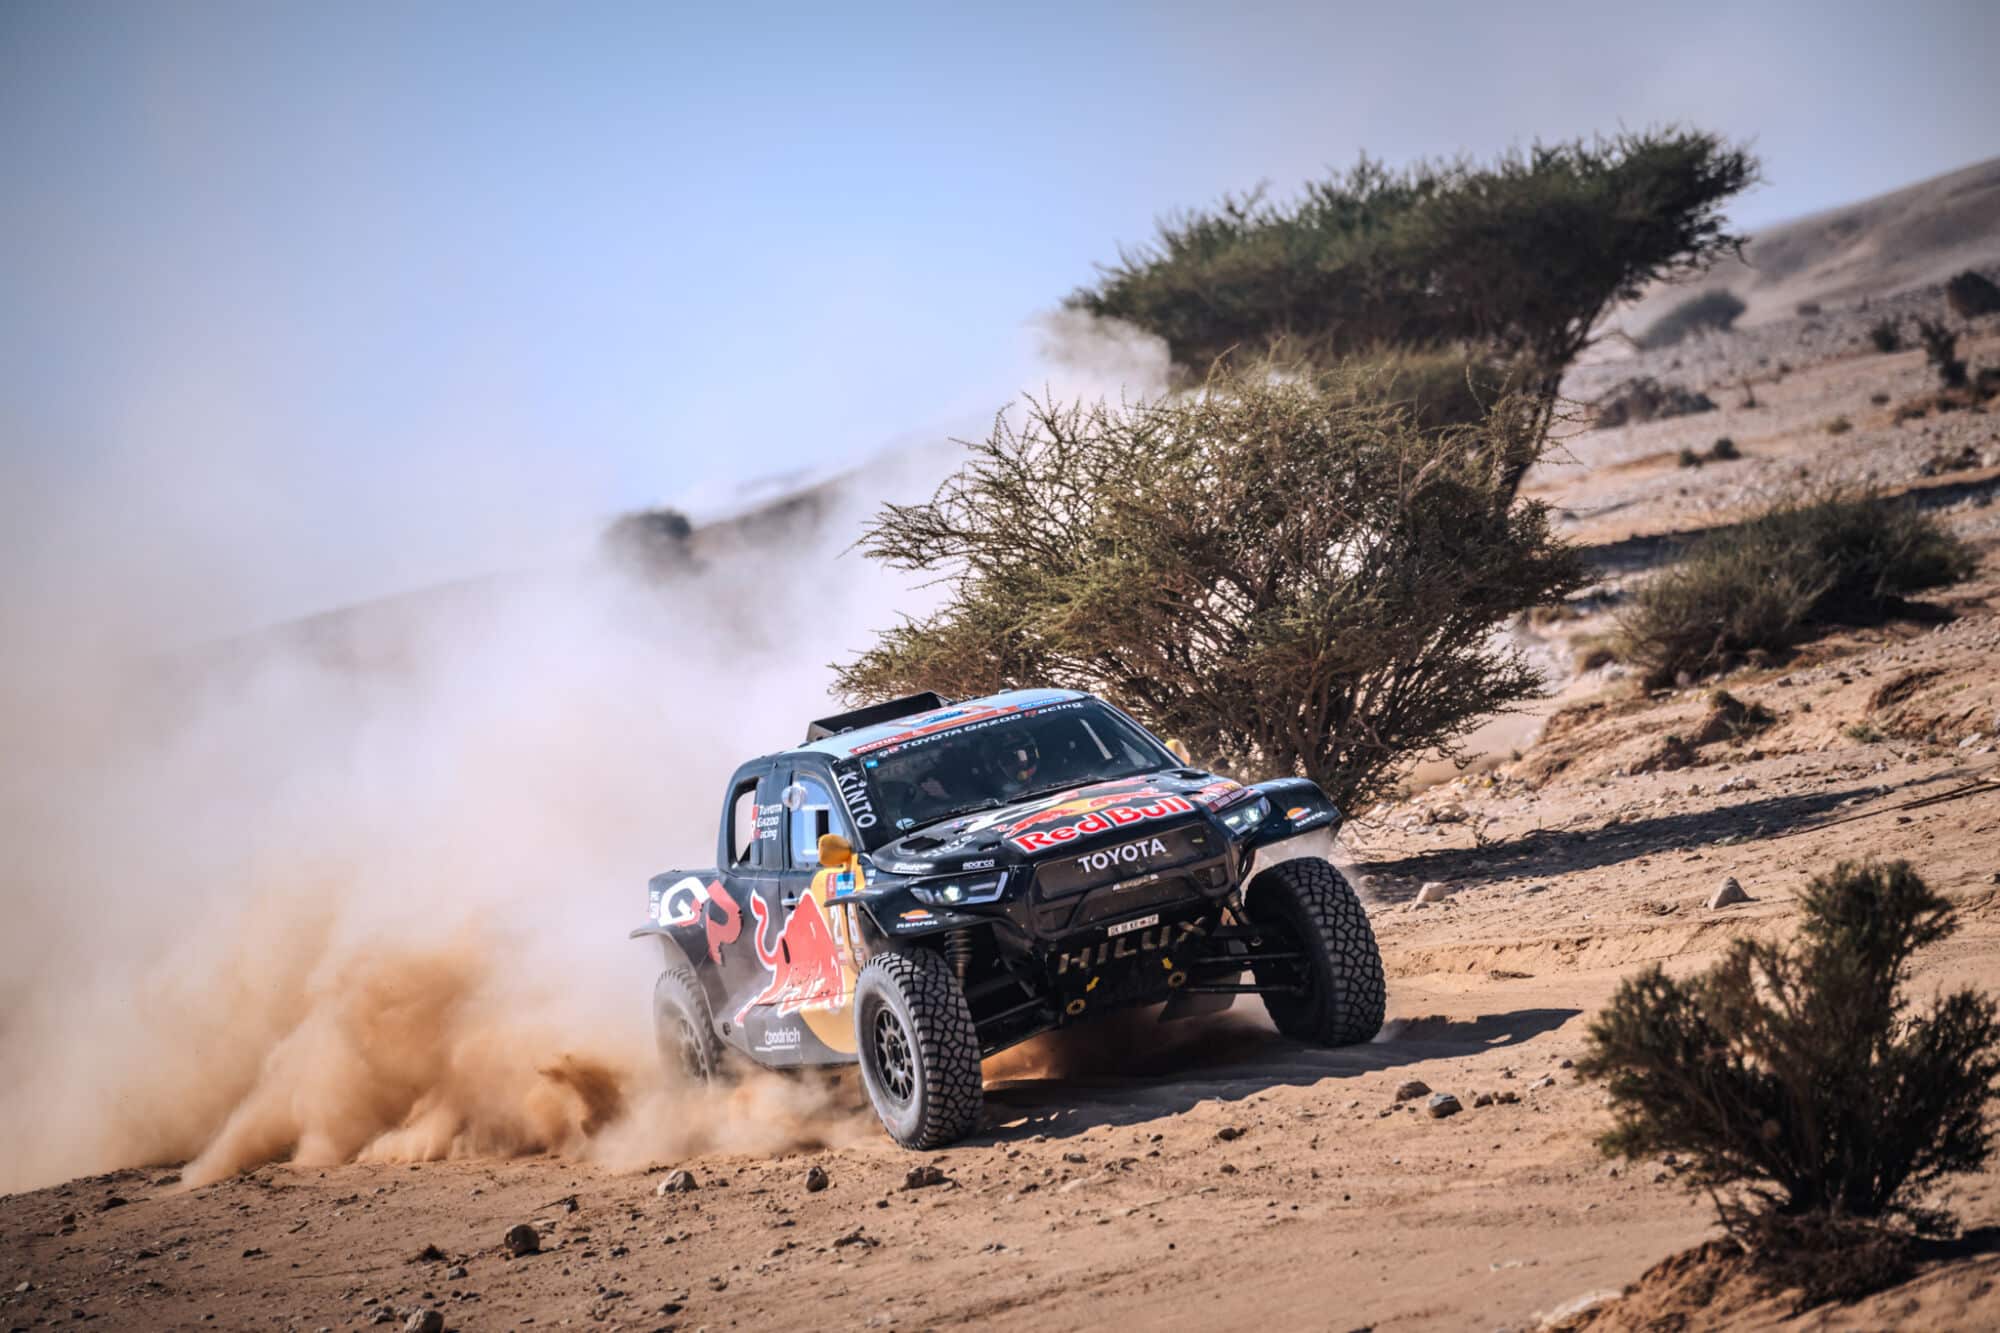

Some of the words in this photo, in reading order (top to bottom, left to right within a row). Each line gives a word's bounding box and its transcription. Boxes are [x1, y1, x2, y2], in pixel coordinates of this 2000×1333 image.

[900, 727, 962, 750] TOYOTA
[963, 713, 1022, 732] GAZOO
[1010, 811, 1113, 853] Red
[1101, 794, 1196, 827] Bull
[1077, 838, 1167, 873] TOYOTA
[1057, 915, 1207, 976] HILUX
